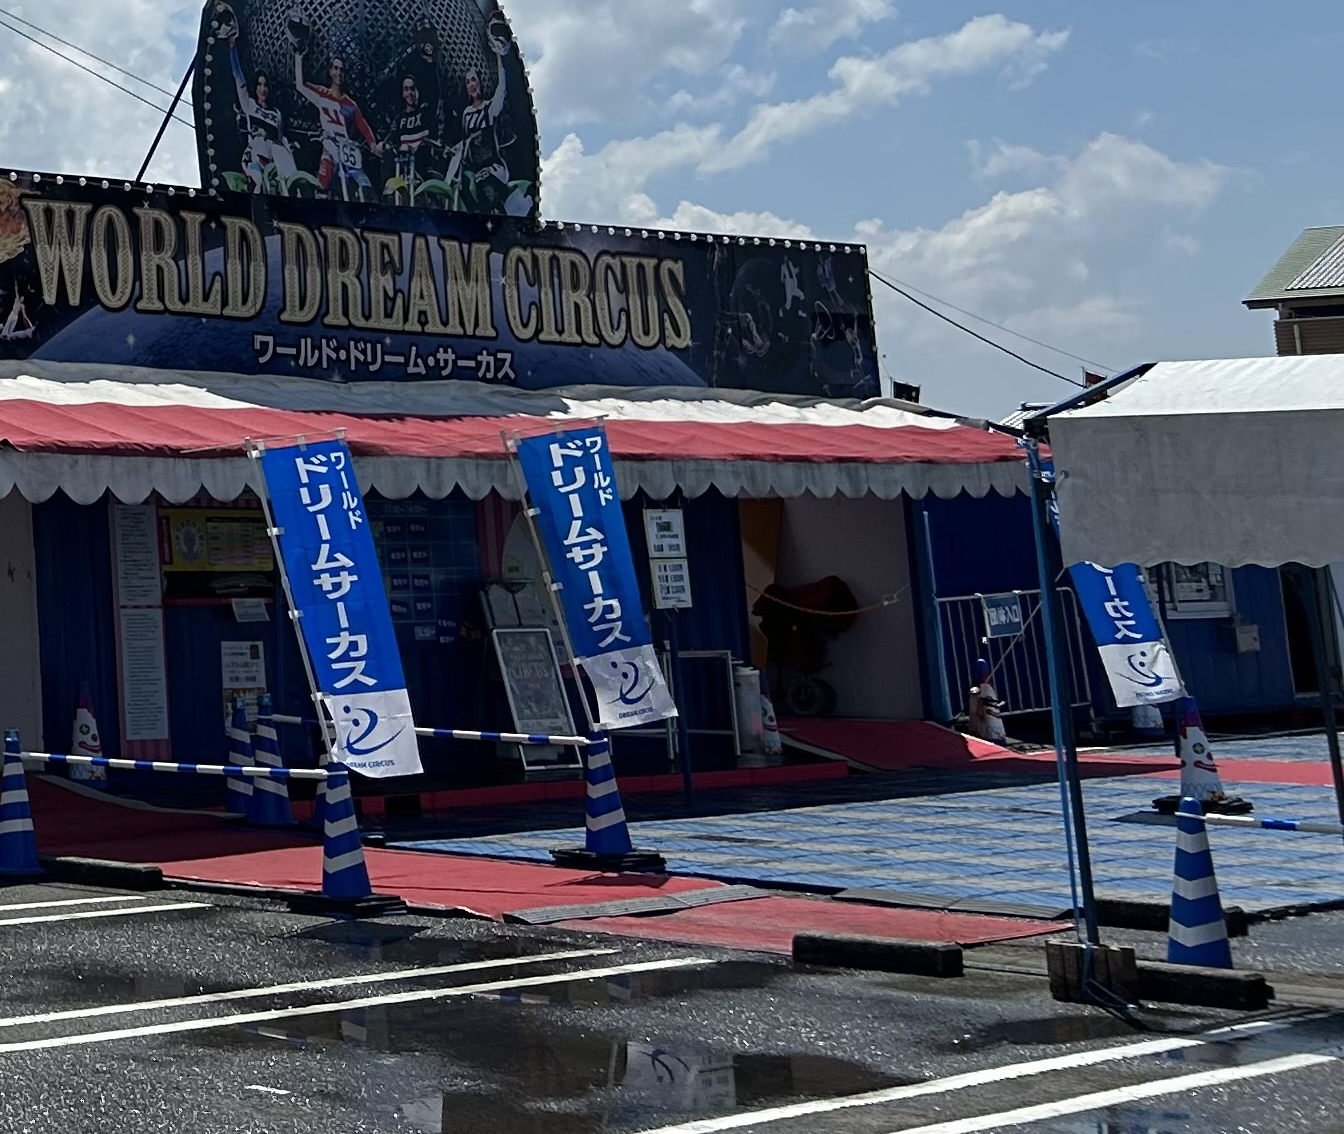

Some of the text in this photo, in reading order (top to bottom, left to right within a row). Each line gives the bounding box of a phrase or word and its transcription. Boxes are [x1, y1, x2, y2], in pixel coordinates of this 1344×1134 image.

[341, 148, 357, 167] 65
[399, 113, 423, 130] FOX
[22, 198, 692, 349] WORLD DREAM CIRCUS
[253, 334, 516, 379] ワールド・ドリーム・サーカス
[329, 451, 363, 530] ワールド
[585, 435, 614, 507] ワールド
[294, 454, 379, 689] ドリームサーカス
[549, 439, 632, 649] ドリームサーカス
